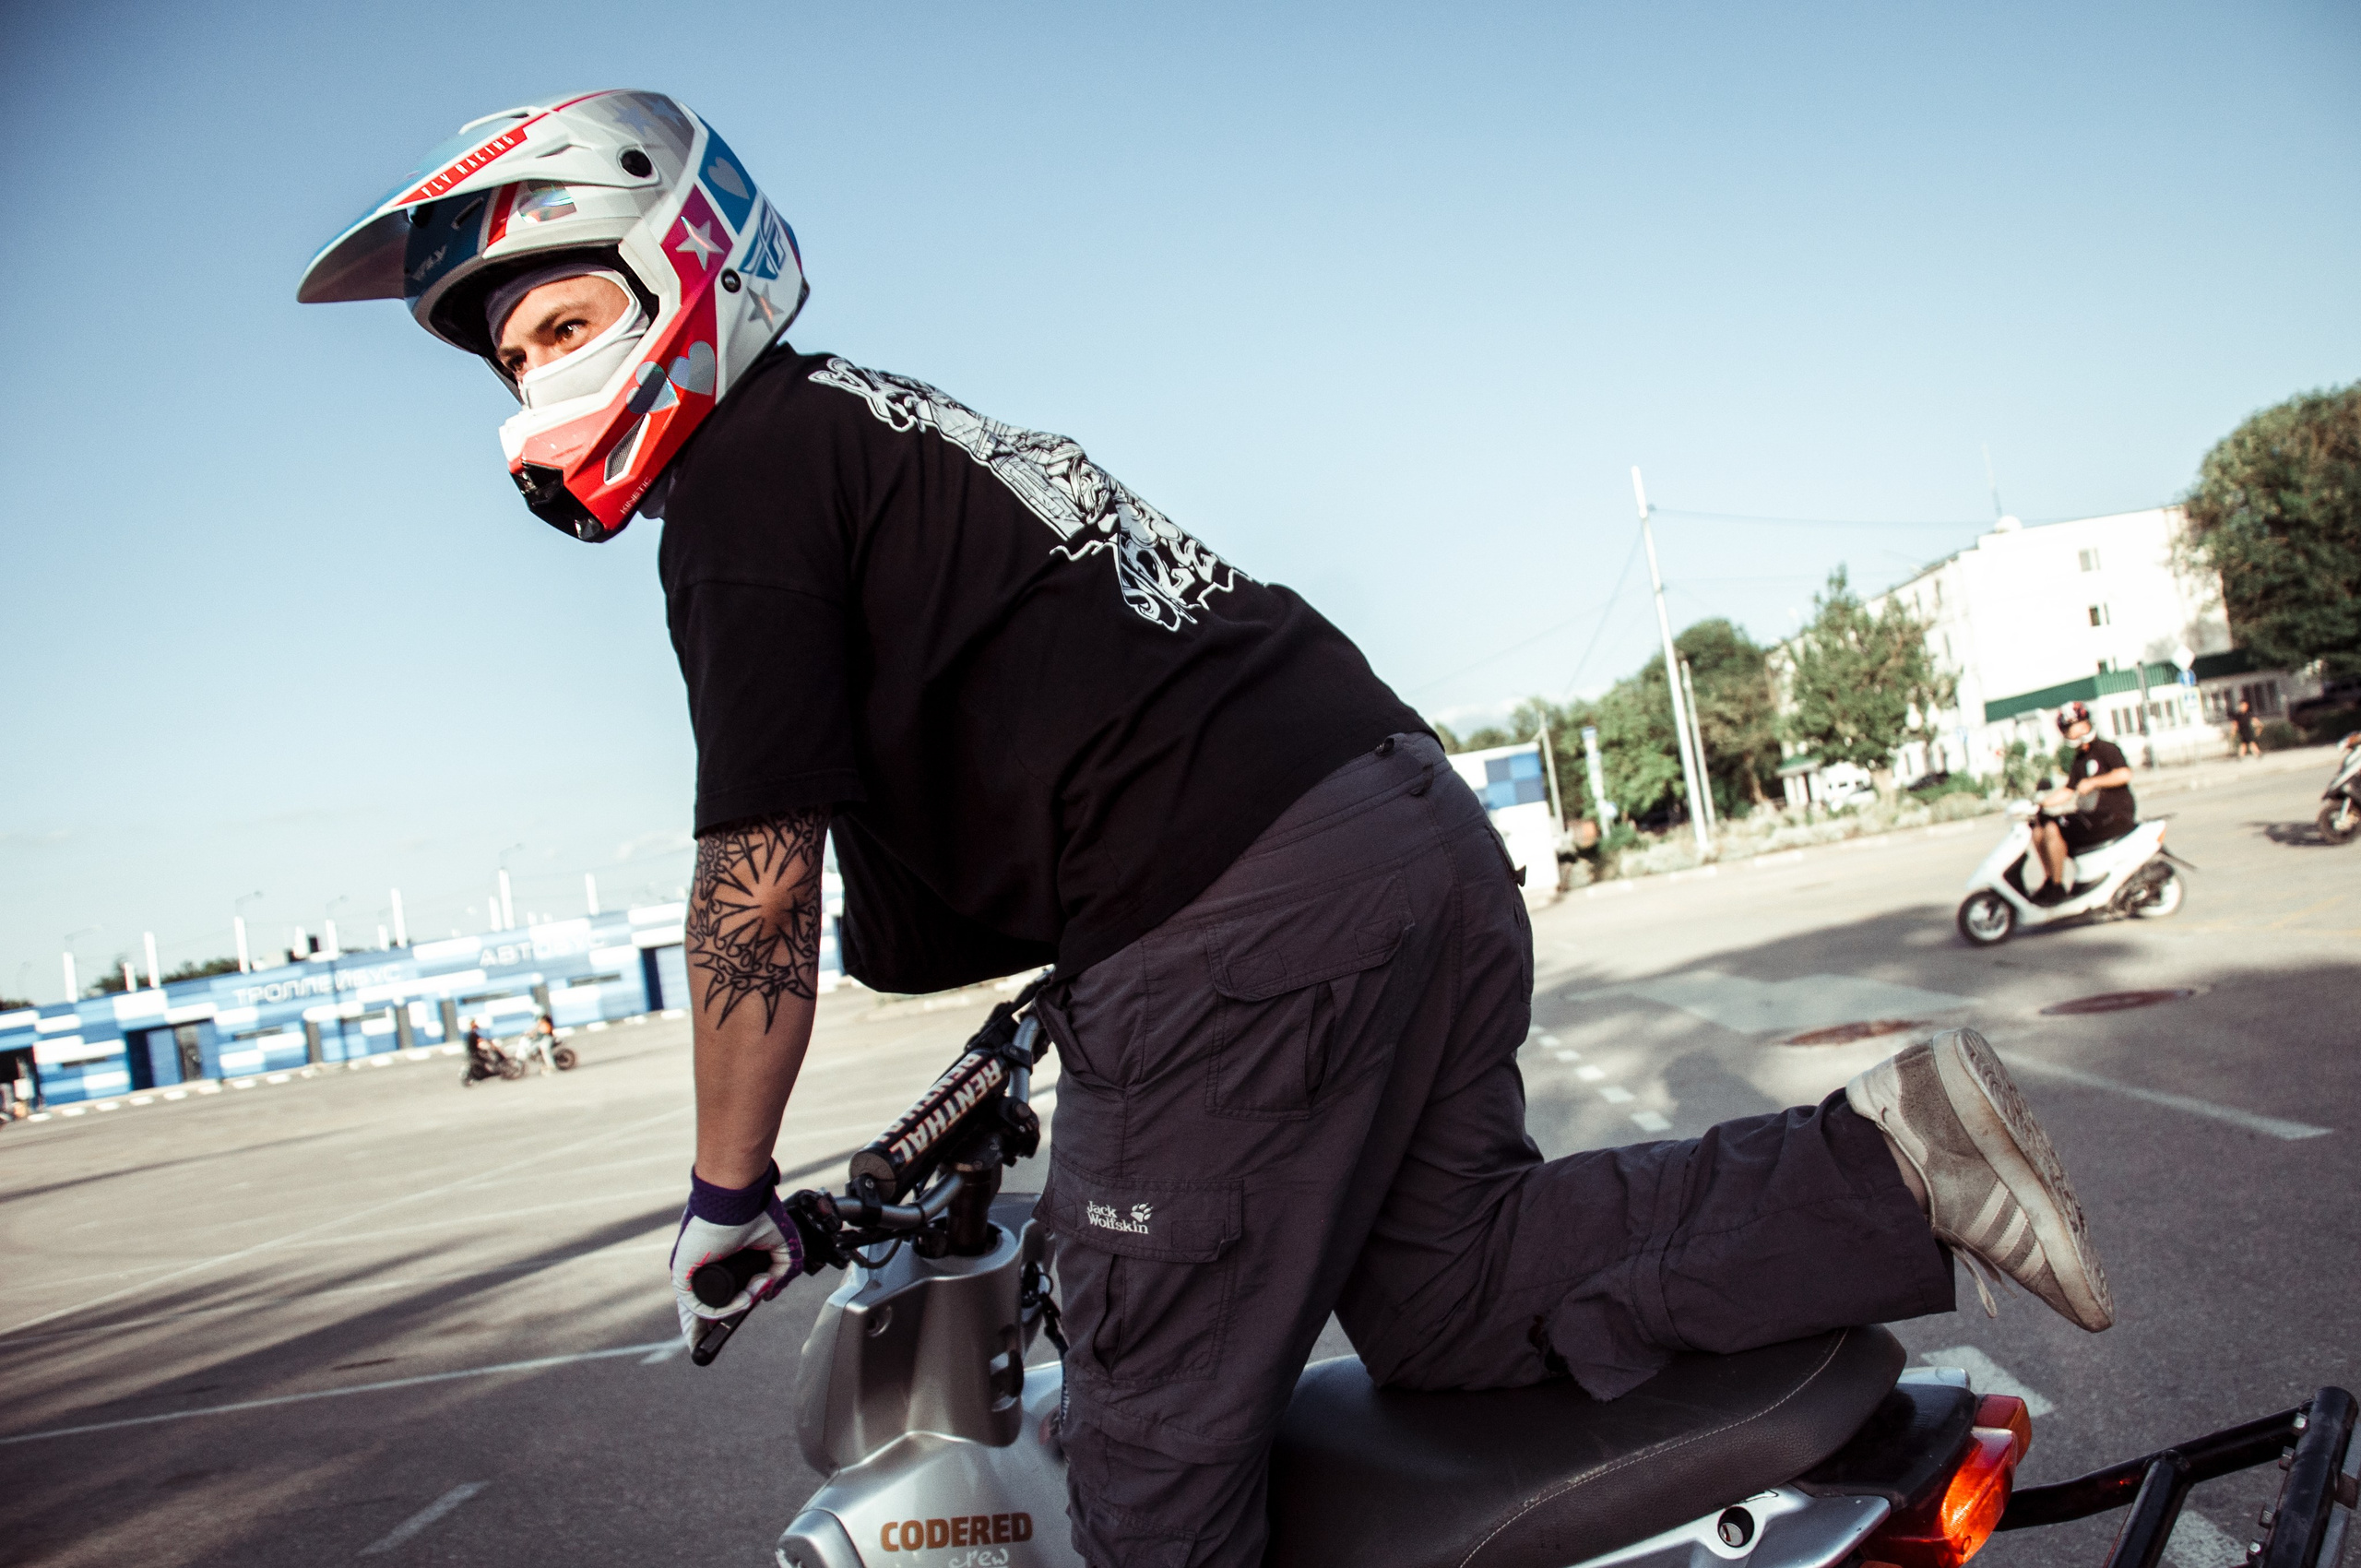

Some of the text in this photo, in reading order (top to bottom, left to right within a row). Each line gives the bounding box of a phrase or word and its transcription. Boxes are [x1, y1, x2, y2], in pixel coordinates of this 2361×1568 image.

[421, 135, 516, 197] FLY RACING
[620, 476, 652, 515] KINETIC
[889, 1058, 1003, 1164] RENTHAL
[1086, 1211, 1149, 1234] Wolfskin
[1087, 1200, 1118, 1218] Jack
[881, 1512, 1033, 1552] CODERED
[948, 1548, 1009, 1568] crew
